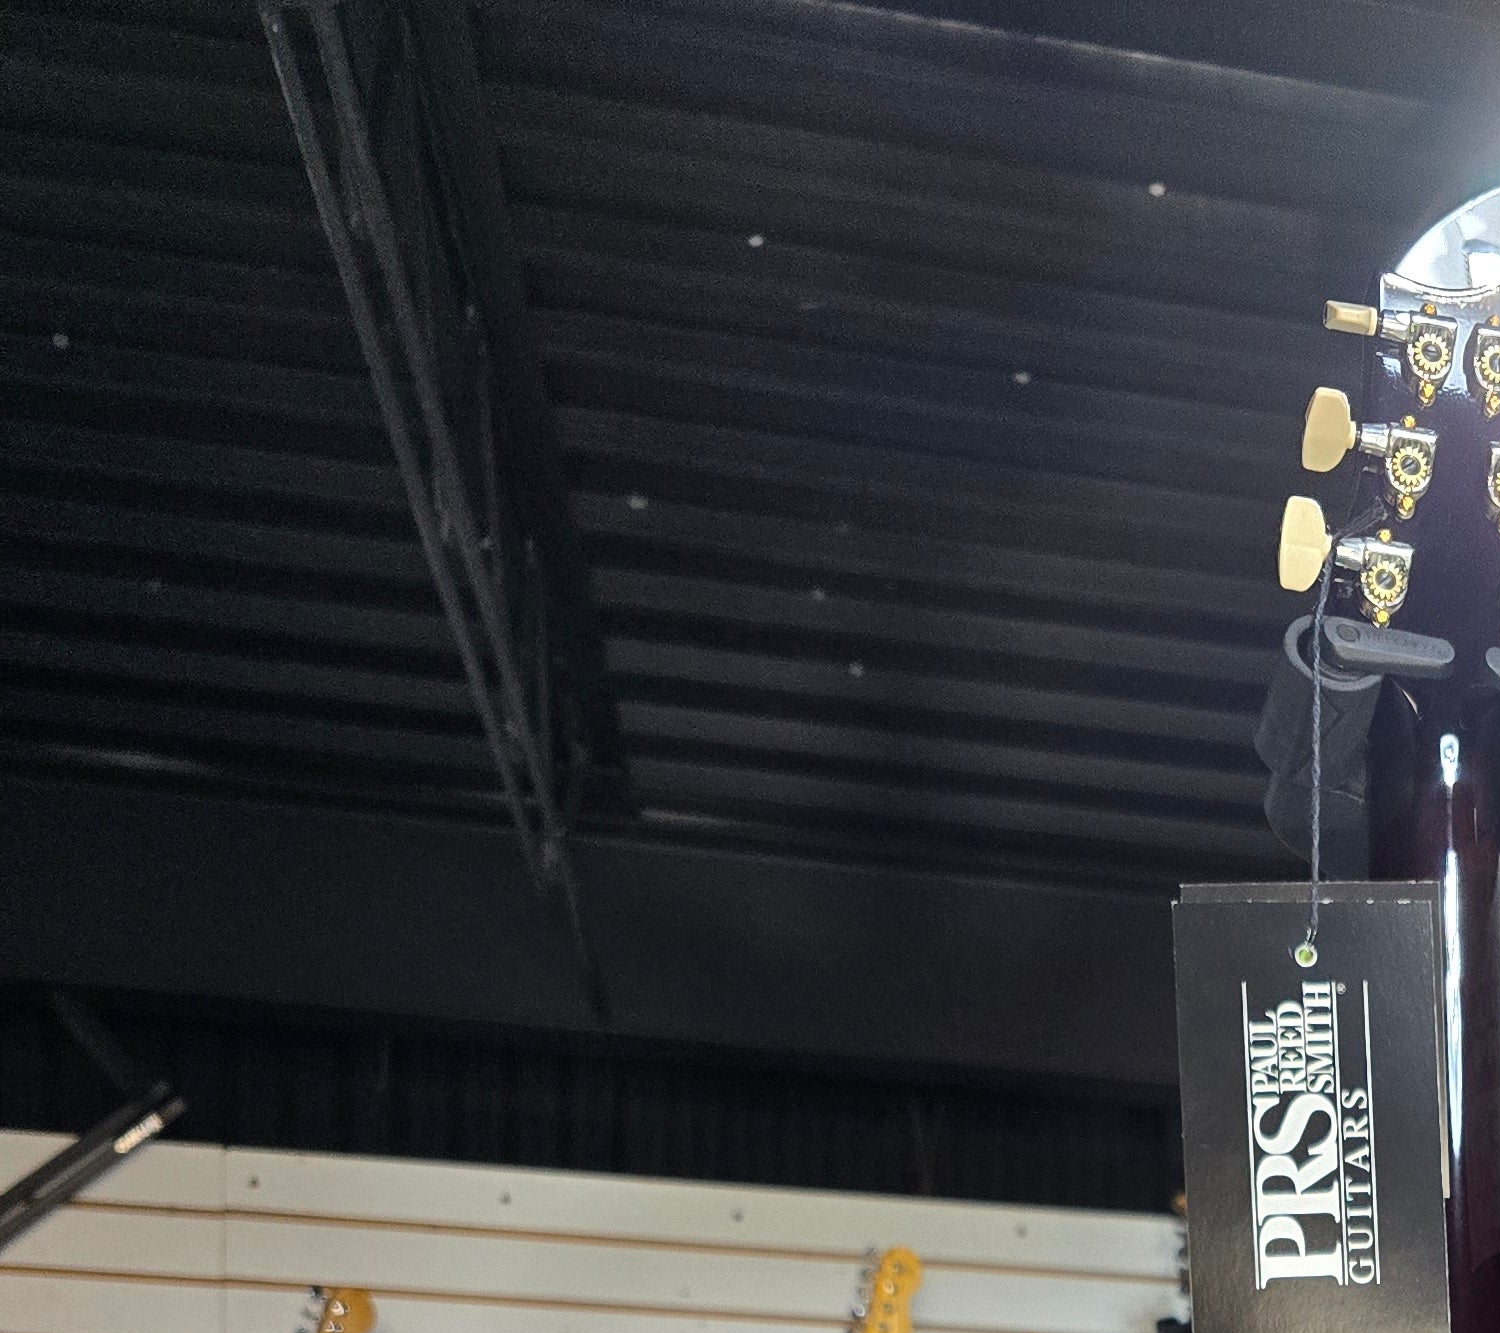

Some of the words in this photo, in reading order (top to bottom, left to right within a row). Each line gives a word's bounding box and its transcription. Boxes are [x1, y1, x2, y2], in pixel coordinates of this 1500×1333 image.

[1249, 1008, 1279, 1097] PAUL
[1277, 1001, 1308, 1094] REED
[1302, 981, 1335, 1093] SMITH
[1253, 1092, 1343, 1290] PRS
[1341, 1087, 1375, 1285] GUITARS
